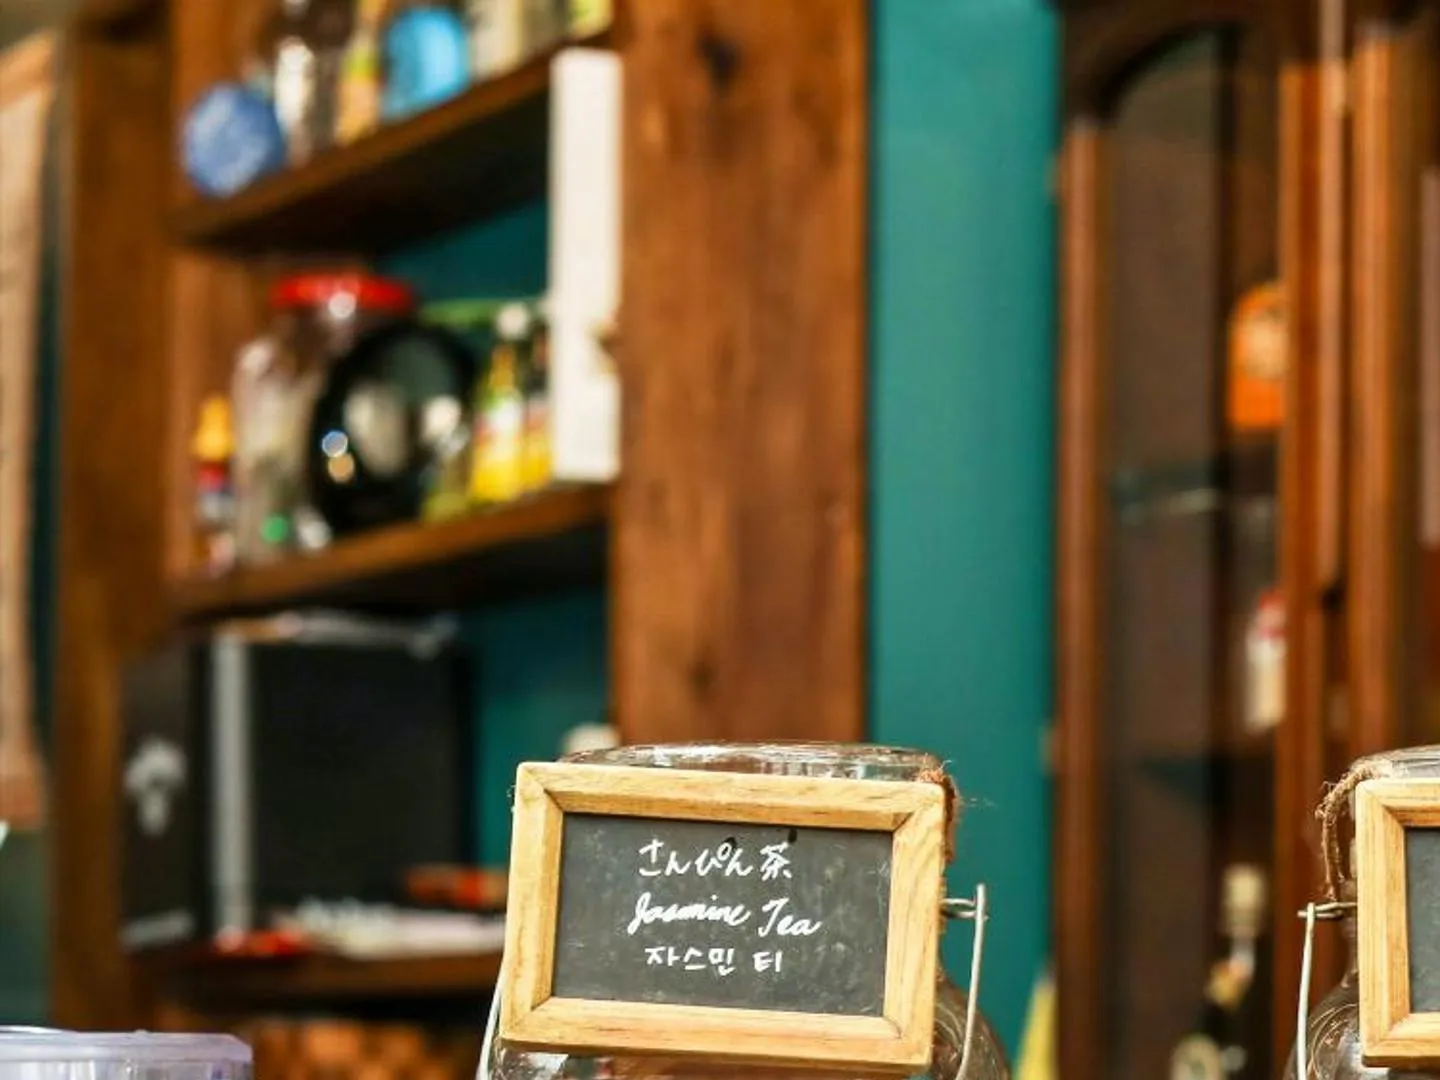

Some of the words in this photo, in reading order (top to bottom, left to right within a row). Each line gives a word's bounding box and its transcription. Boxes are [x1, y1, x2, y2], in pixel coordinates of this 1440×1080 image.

[626, 891, 751, 936] Jasmine
[758, 897, 823, 938] Tea
[644, 945, 736, 976] 자스민
[752, 950, 783, 973] 티
